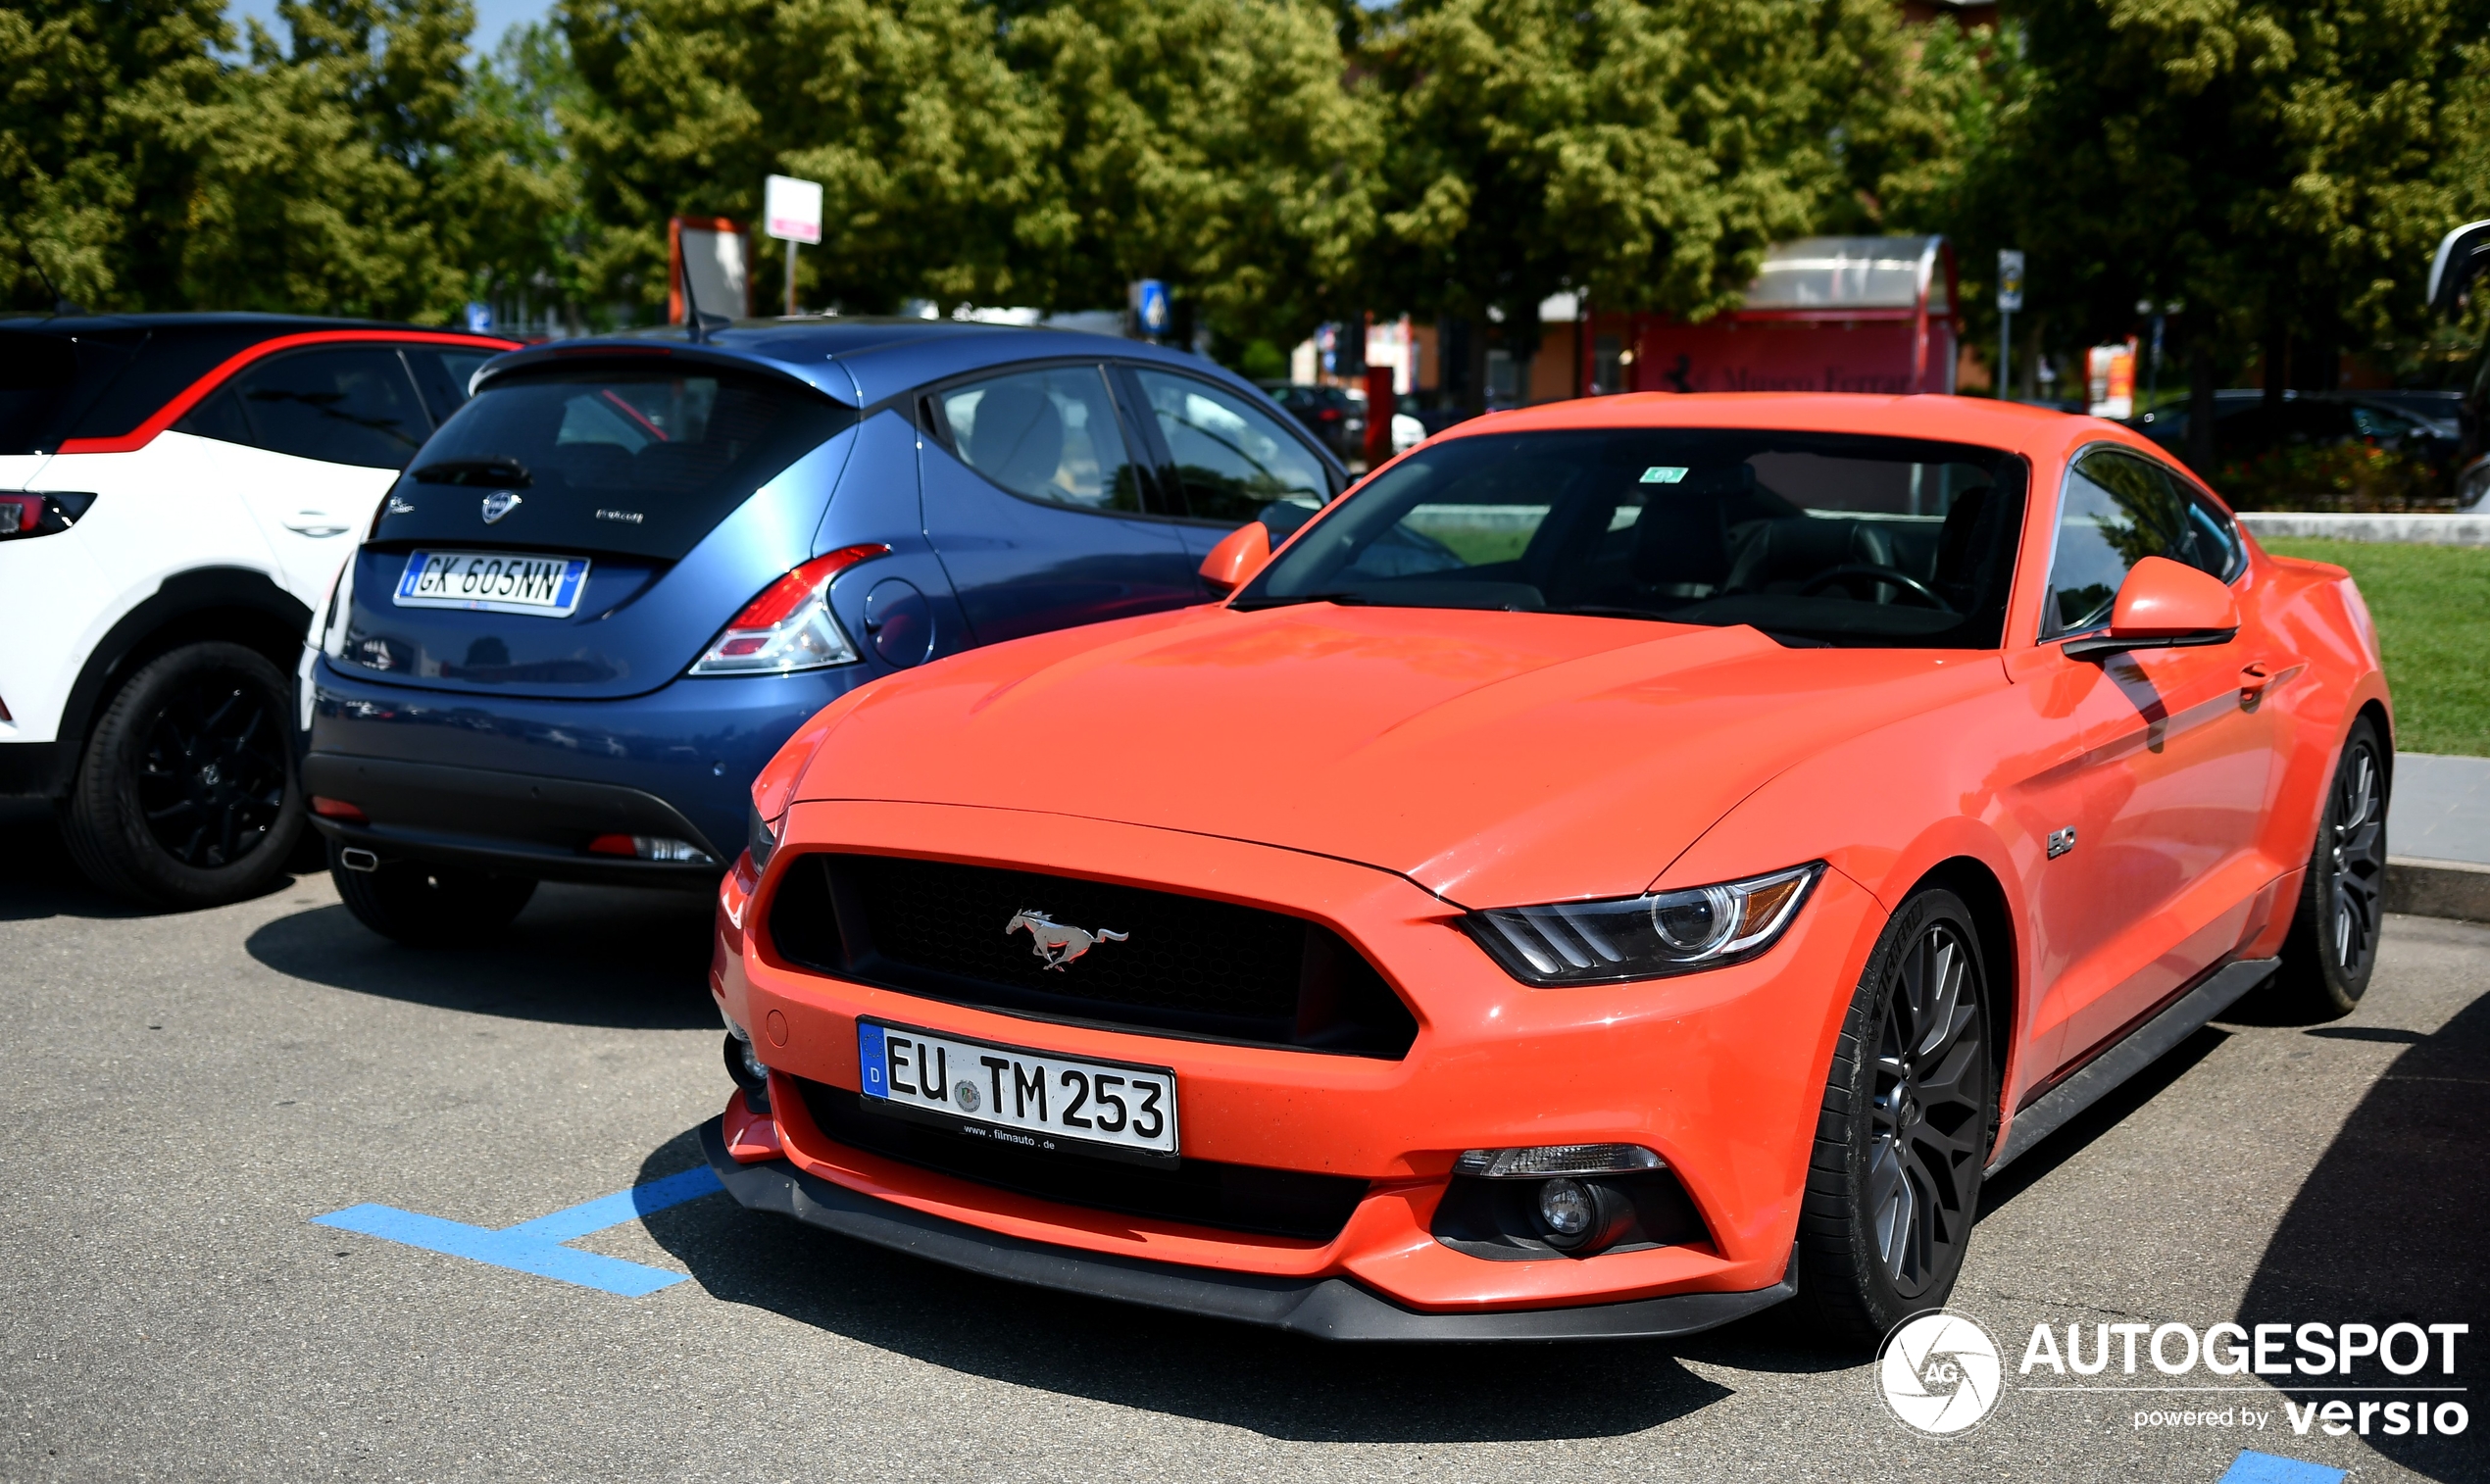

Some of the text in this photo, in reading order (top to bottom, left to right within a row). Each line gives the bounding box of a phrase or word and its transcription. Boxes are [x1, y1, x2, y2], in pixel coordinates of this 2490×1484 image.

[1824, 365, 1913, 392] Ferrar
[420, 556, 563, 601] GK 605NN
[871, 1066, 880, 1083] D
[886, 1035, 949, 1102] EU
[980, 1055, 1048, 1122] TM
[1060, 1069, 1164, 1139] 253
